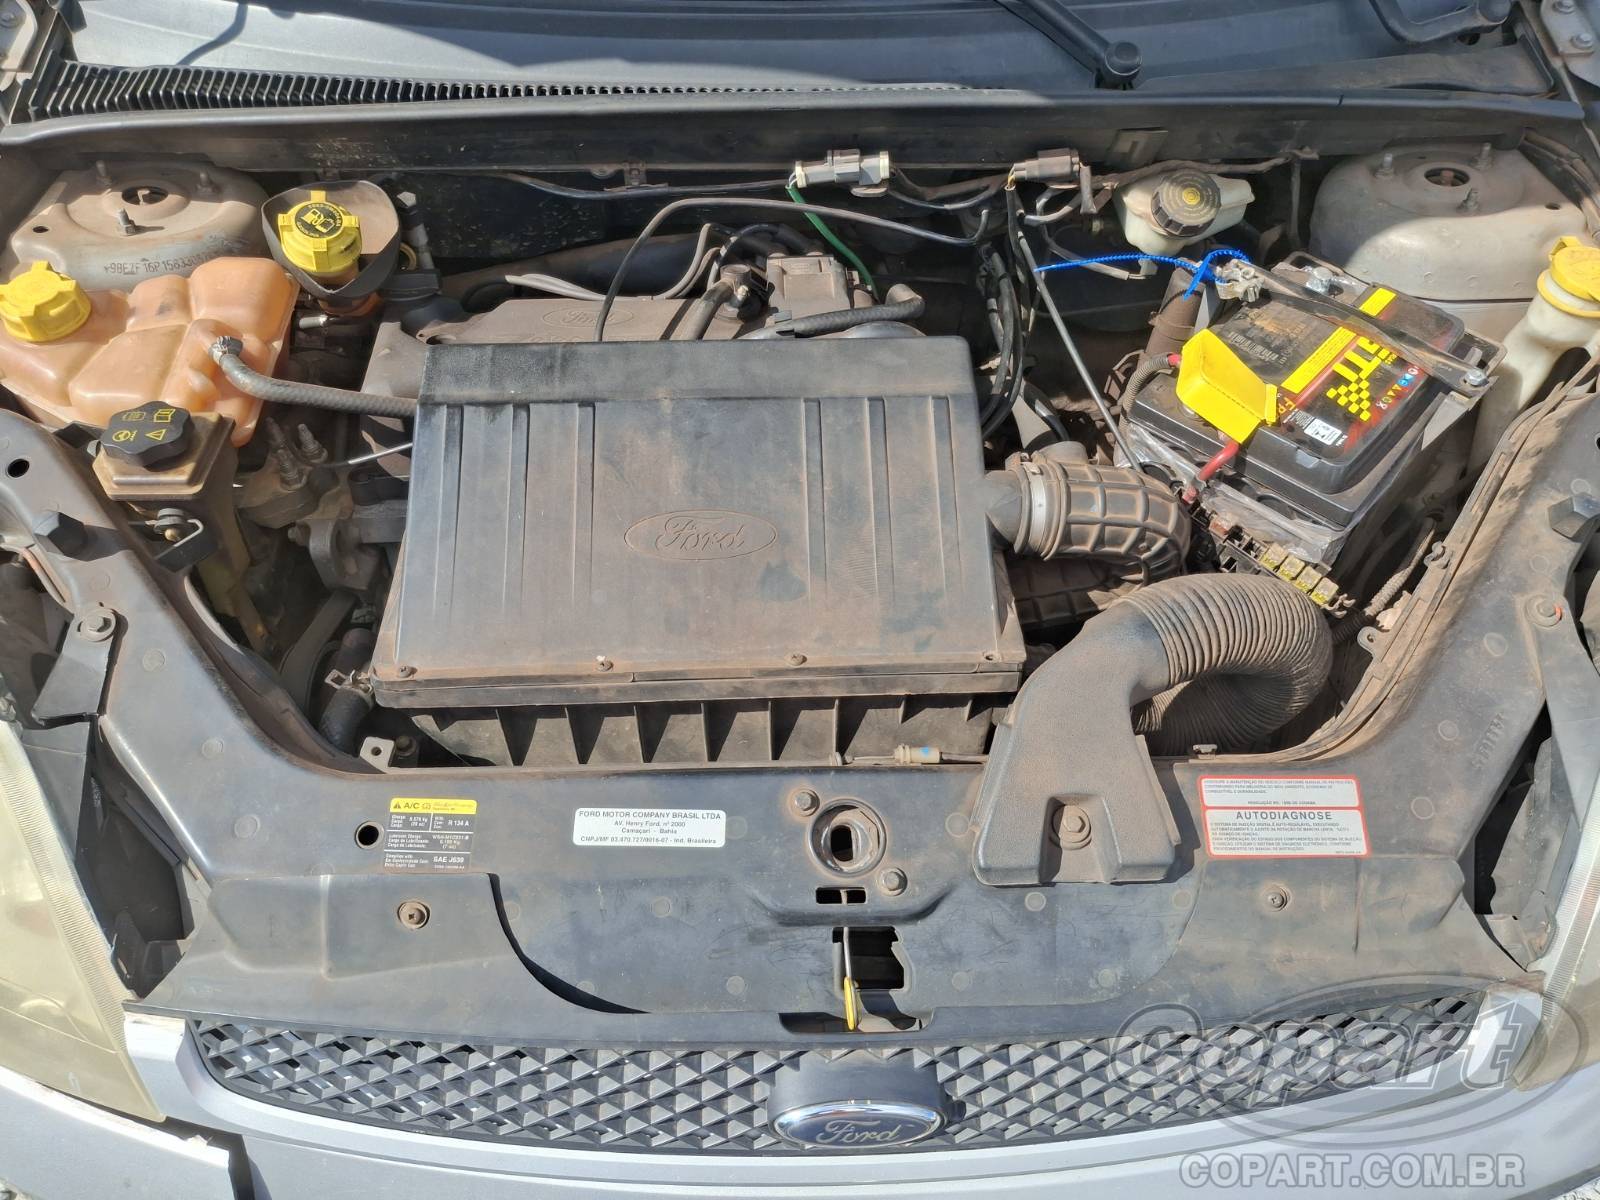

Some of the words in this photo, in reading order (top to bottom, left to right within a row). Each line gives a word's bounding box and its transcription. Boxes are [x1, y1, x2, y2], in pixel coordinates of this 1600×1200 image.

[655, 515, 746, 552] Ford
[404, 802, 420, 810] A/C
[1236, 811, 1332, 819] AUTODIAGNOSE
[815, 1118, 902, 1144] Ford
